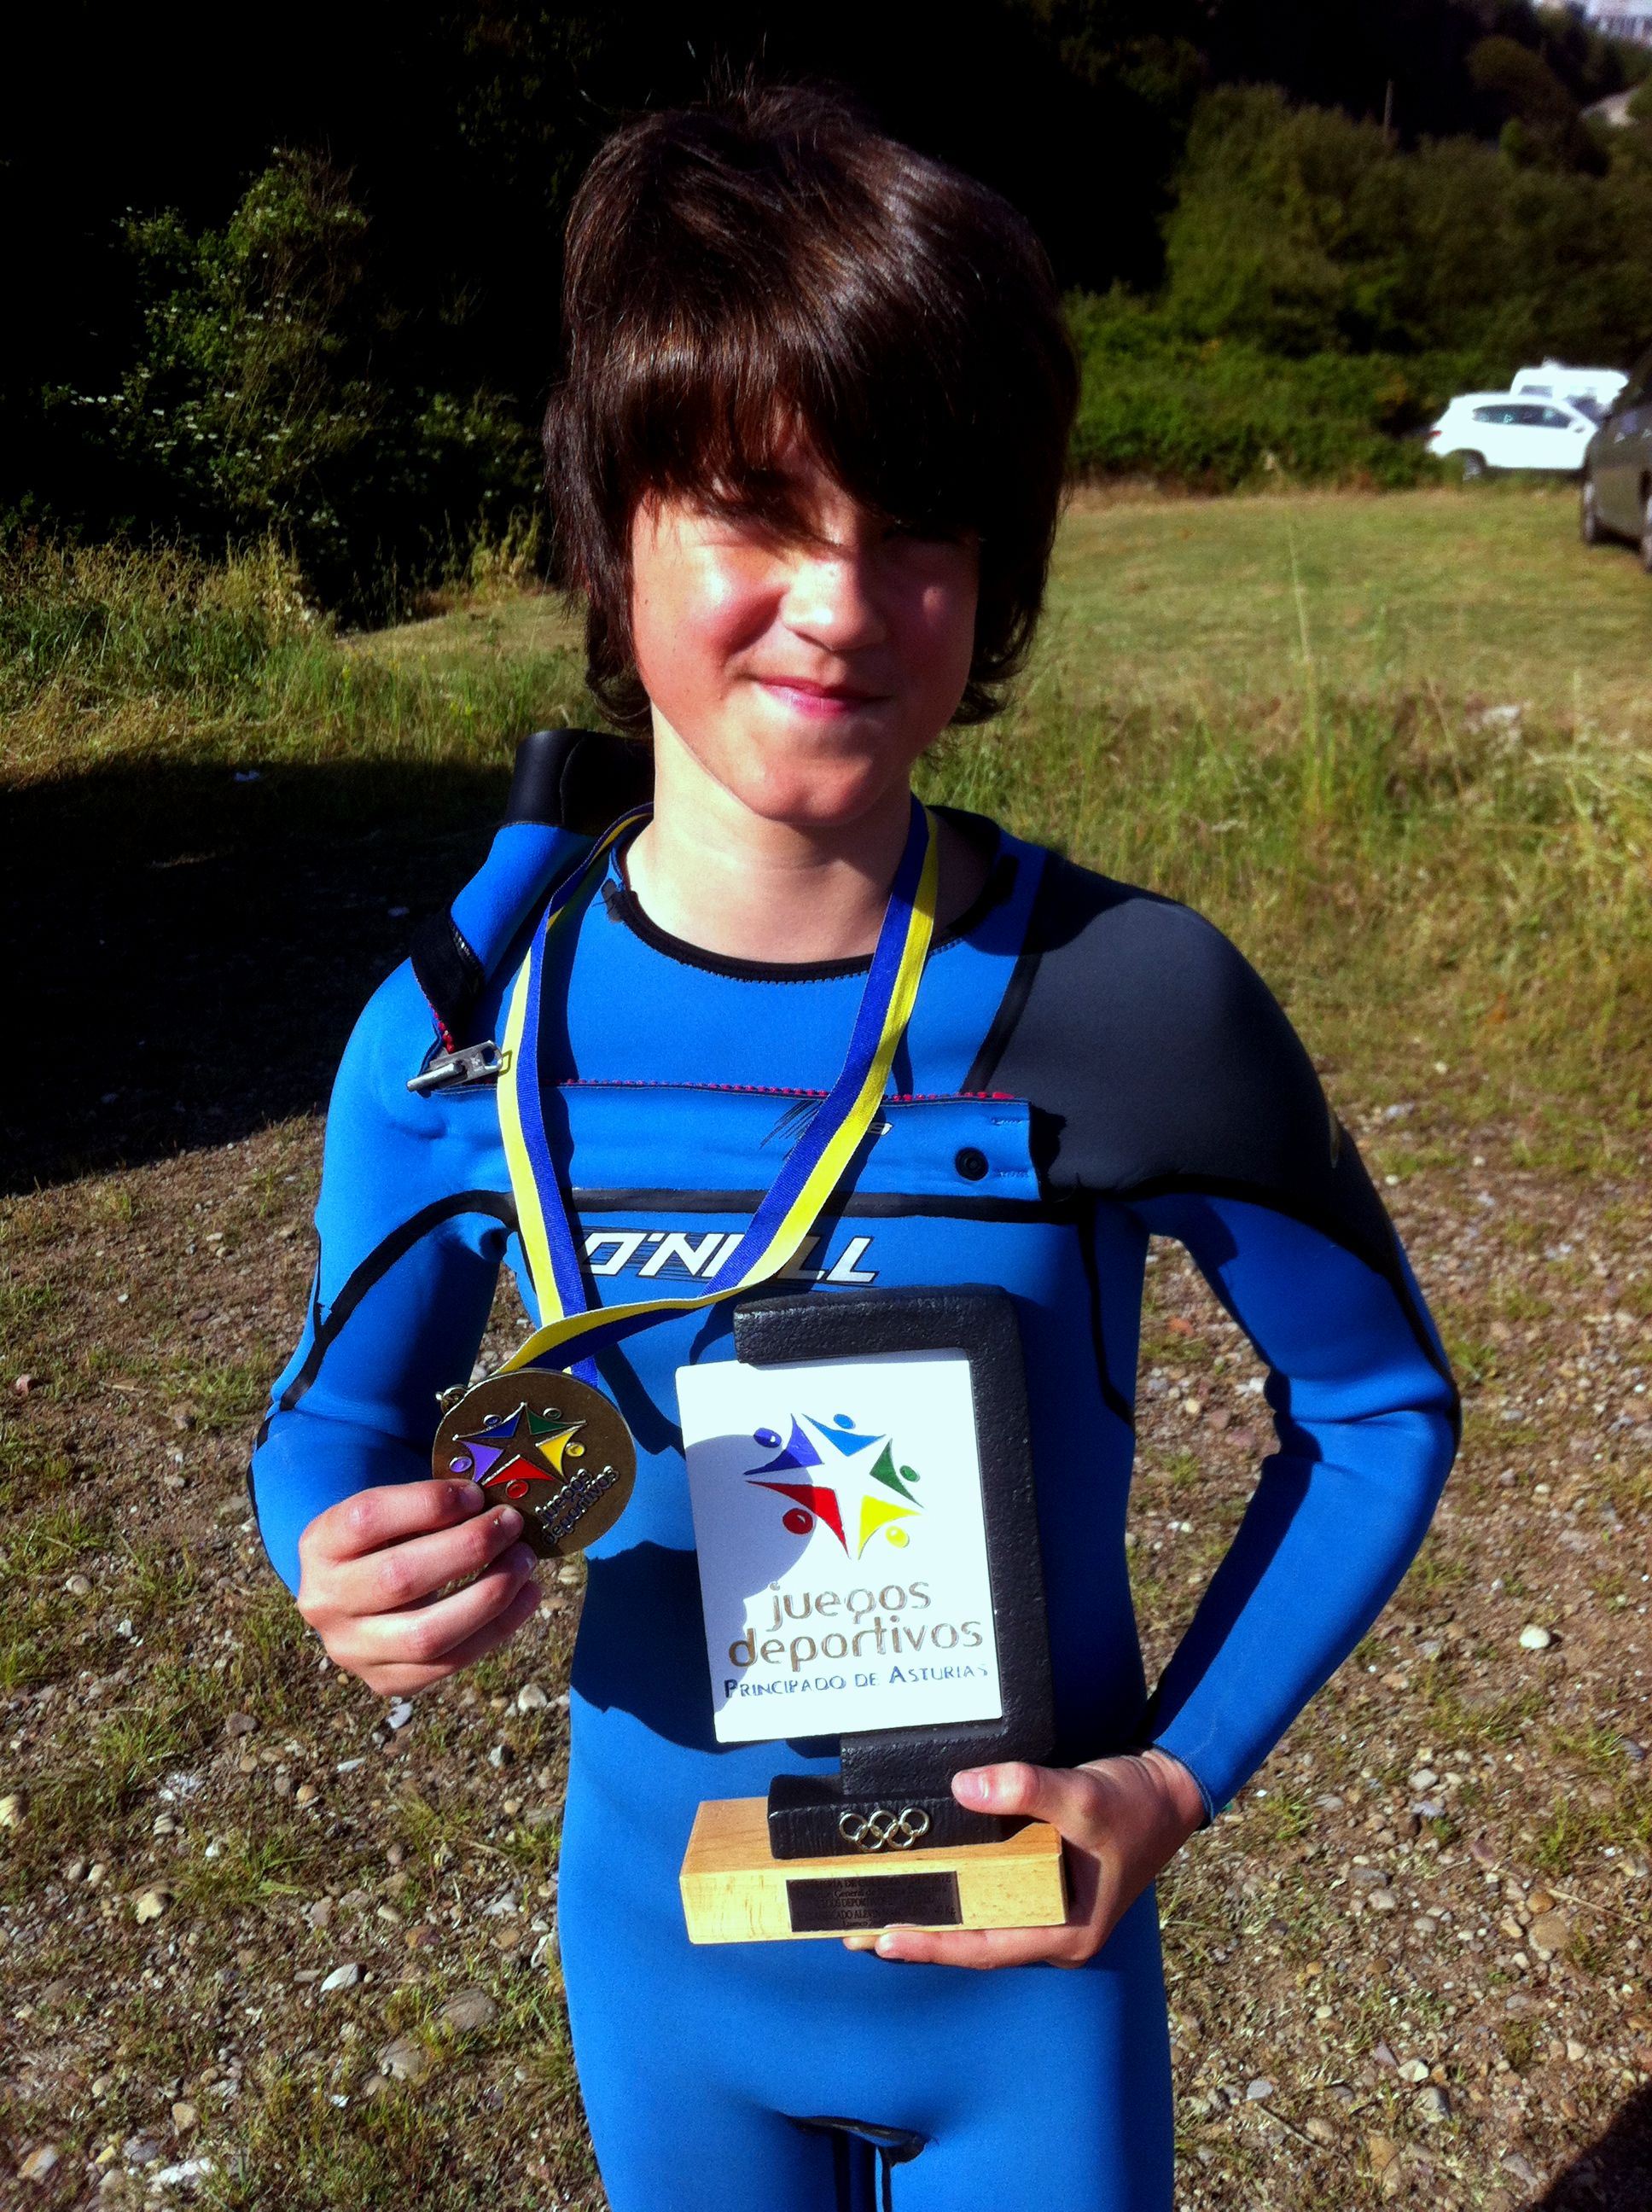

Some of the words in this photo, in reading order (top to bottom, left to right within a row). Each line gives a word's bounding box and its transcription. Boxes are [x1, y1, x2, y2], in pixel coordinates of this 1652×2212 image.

[765, 1580, 932, 1632] juegos
[728, 1615, 984, 1673] deportivos
[724, 1674, 847, 1698] PRINCIPADO
[854, 1673, 880, 1688] DE
[889, 1663, 989, 1685] ASTURIAS
